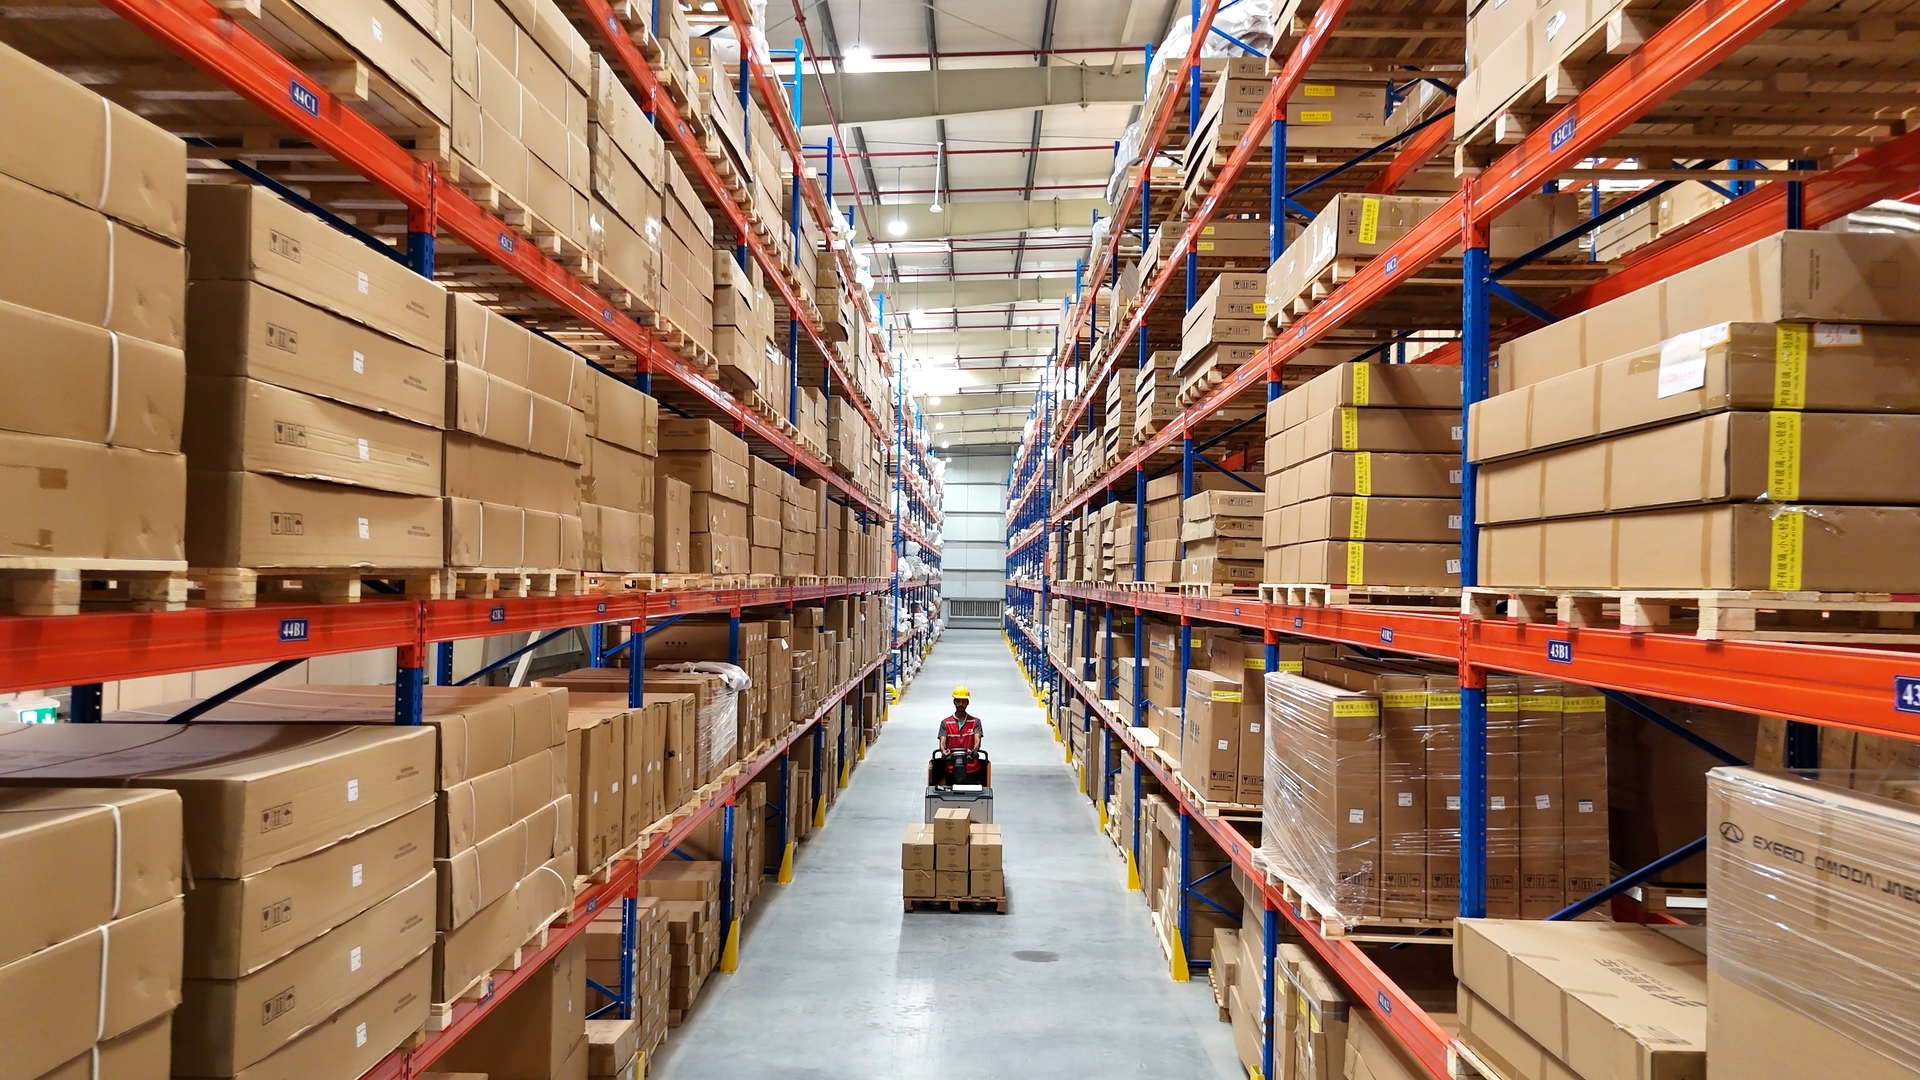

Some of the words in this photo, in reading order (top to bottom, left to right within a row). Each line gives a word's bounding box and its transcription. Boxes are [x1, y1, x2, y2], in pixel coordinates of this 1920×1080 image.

[294, 86, 317, 113] 44C1
[1553, 121, 1575, 146] 43C1
[1775, 415, 1787, 495] 内有玻璃,小心轻放!
[283, 622, 305, 637] 44B1
[1550, 643, 1569, 660] 43B1
[1753, 835, 1805, 865] EXEED
